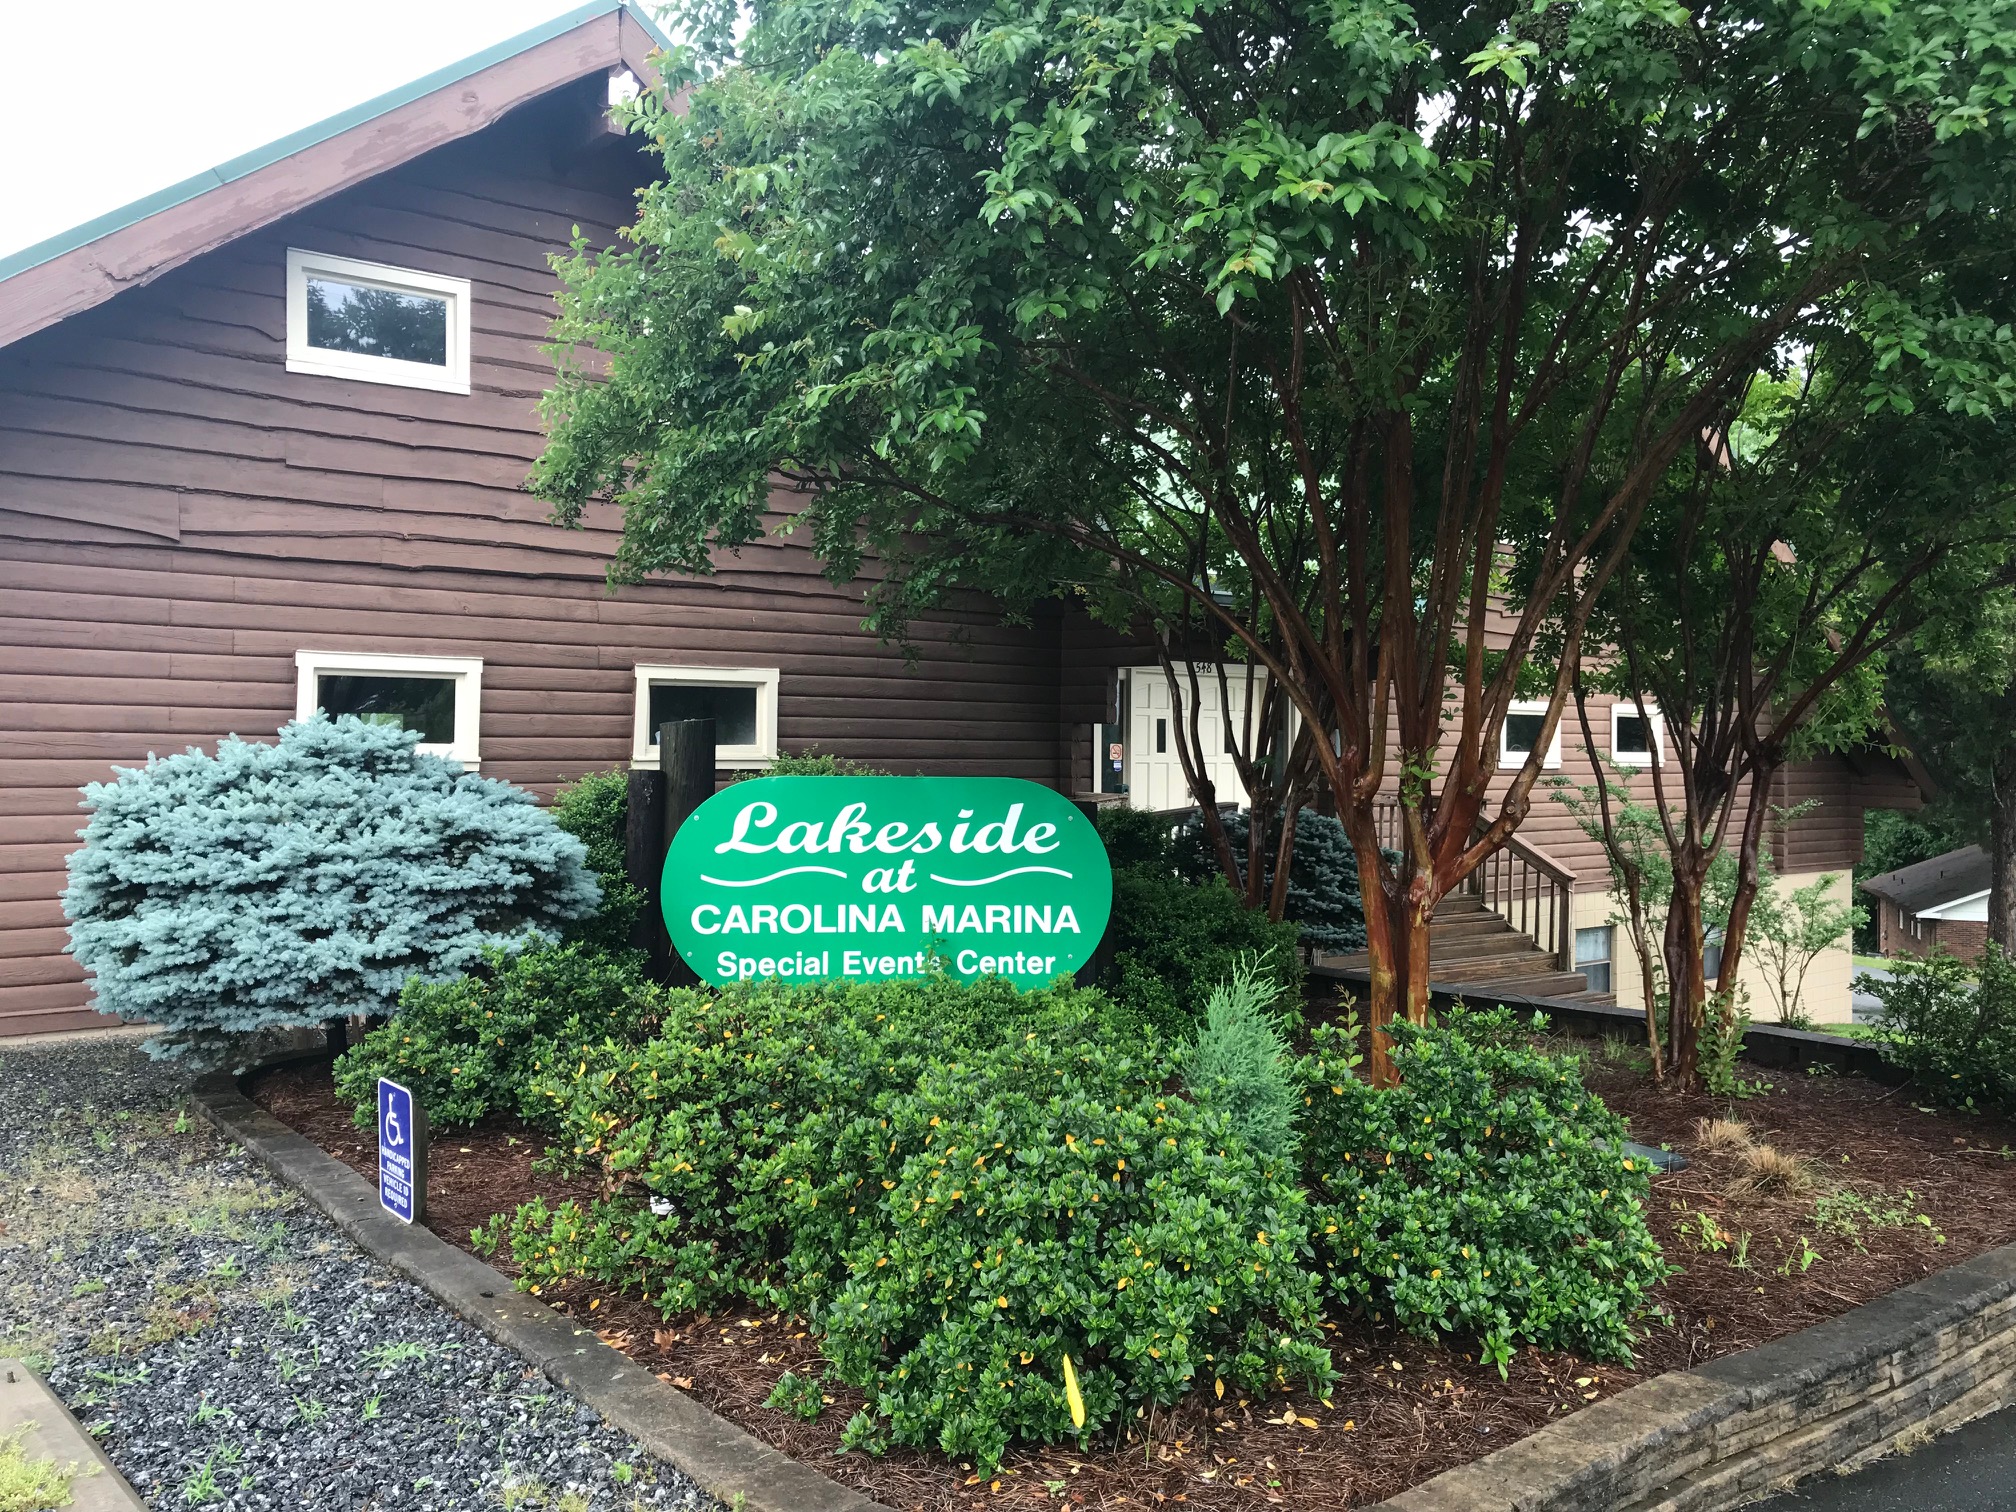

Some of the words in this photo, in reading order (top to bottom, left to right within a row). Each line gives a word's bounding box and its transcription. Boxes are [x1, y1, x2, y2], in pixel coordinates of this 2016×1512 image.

[714, 801, 1060, 854] Lakeside
[861, 859, 917, 894] at
[690, 904, 905, 935] CAROLINA
[921, 904, 1081, 934] MARINA
[716, 951, 829, 980] Special
[956, 949, 1056, 975] Center
[381, 1145, 410, 1170] HANDICAPPED
[386, 1160, 405, 1179] PARKING
[383, 1173, 403, 1193] VEHICLE
[384, 1186, 408, 1209] REQUIRED
